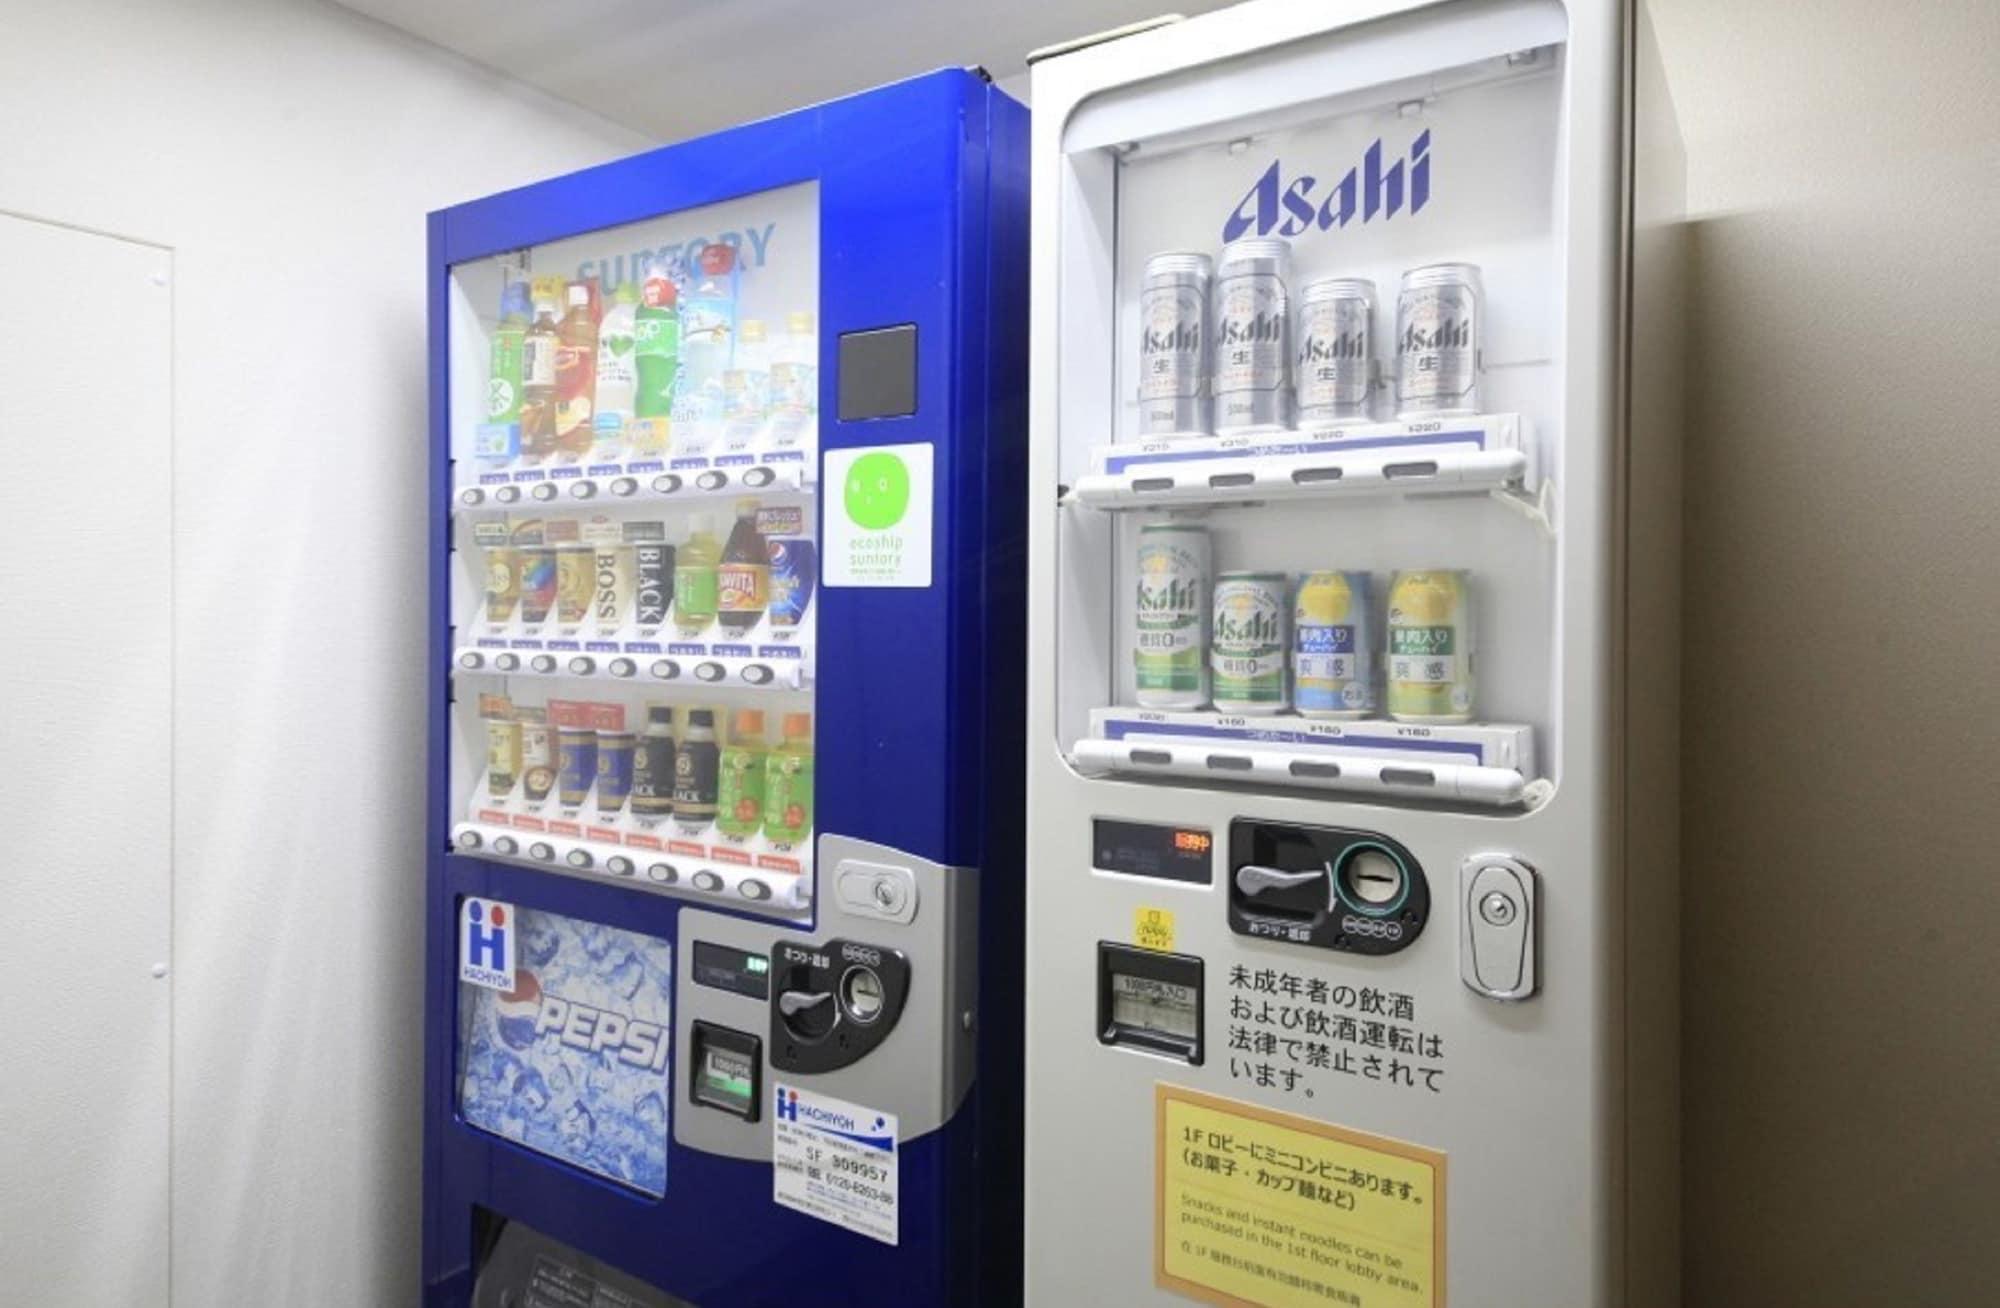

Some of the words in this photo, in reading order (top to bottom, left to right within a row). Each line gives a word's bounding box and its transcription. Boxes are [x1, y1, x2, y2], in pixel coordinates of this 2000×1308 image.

[1222, 128, 1430, 244] Asahi
[850, 535, 904, 551] ecoship
[597, 554, 616, 618] BOSS
[639, 548, 662, 620] BLACK
[1229, 964, 1415, 1022] 未成年者の飲酒
[1230, 995, 1444, 1058] および飲酒運転は
[535, 993, 668, 1074] PEPSI
[1228, 1025, 1444, 1093] 法律で禁止されて
[1230, 1057, 1314, 1098] います。
[1181, 1193, 1223, 1217] Snacks
[1226, 1206, 1250, 1224] and
[1253, 1211, 1297, 1237] instant
[1300, 1225, 1353, 1255] noodles
[1355, 1245, 1382, 1264] can
[1384, 1252, 1403, 1270] be
[1181, 1211, 1243, 1239] purchased
[1246, 1228, 1259, 1243] in
[1262, 1232, 1284, 1251] the
[1287, 1242, 1306, 1259] 1st
[1310, 1247, 1342, 1269] floor
[1345, 1258, 1383, 1284] lobby
[1387, 1272, 1424, 1296] area.
